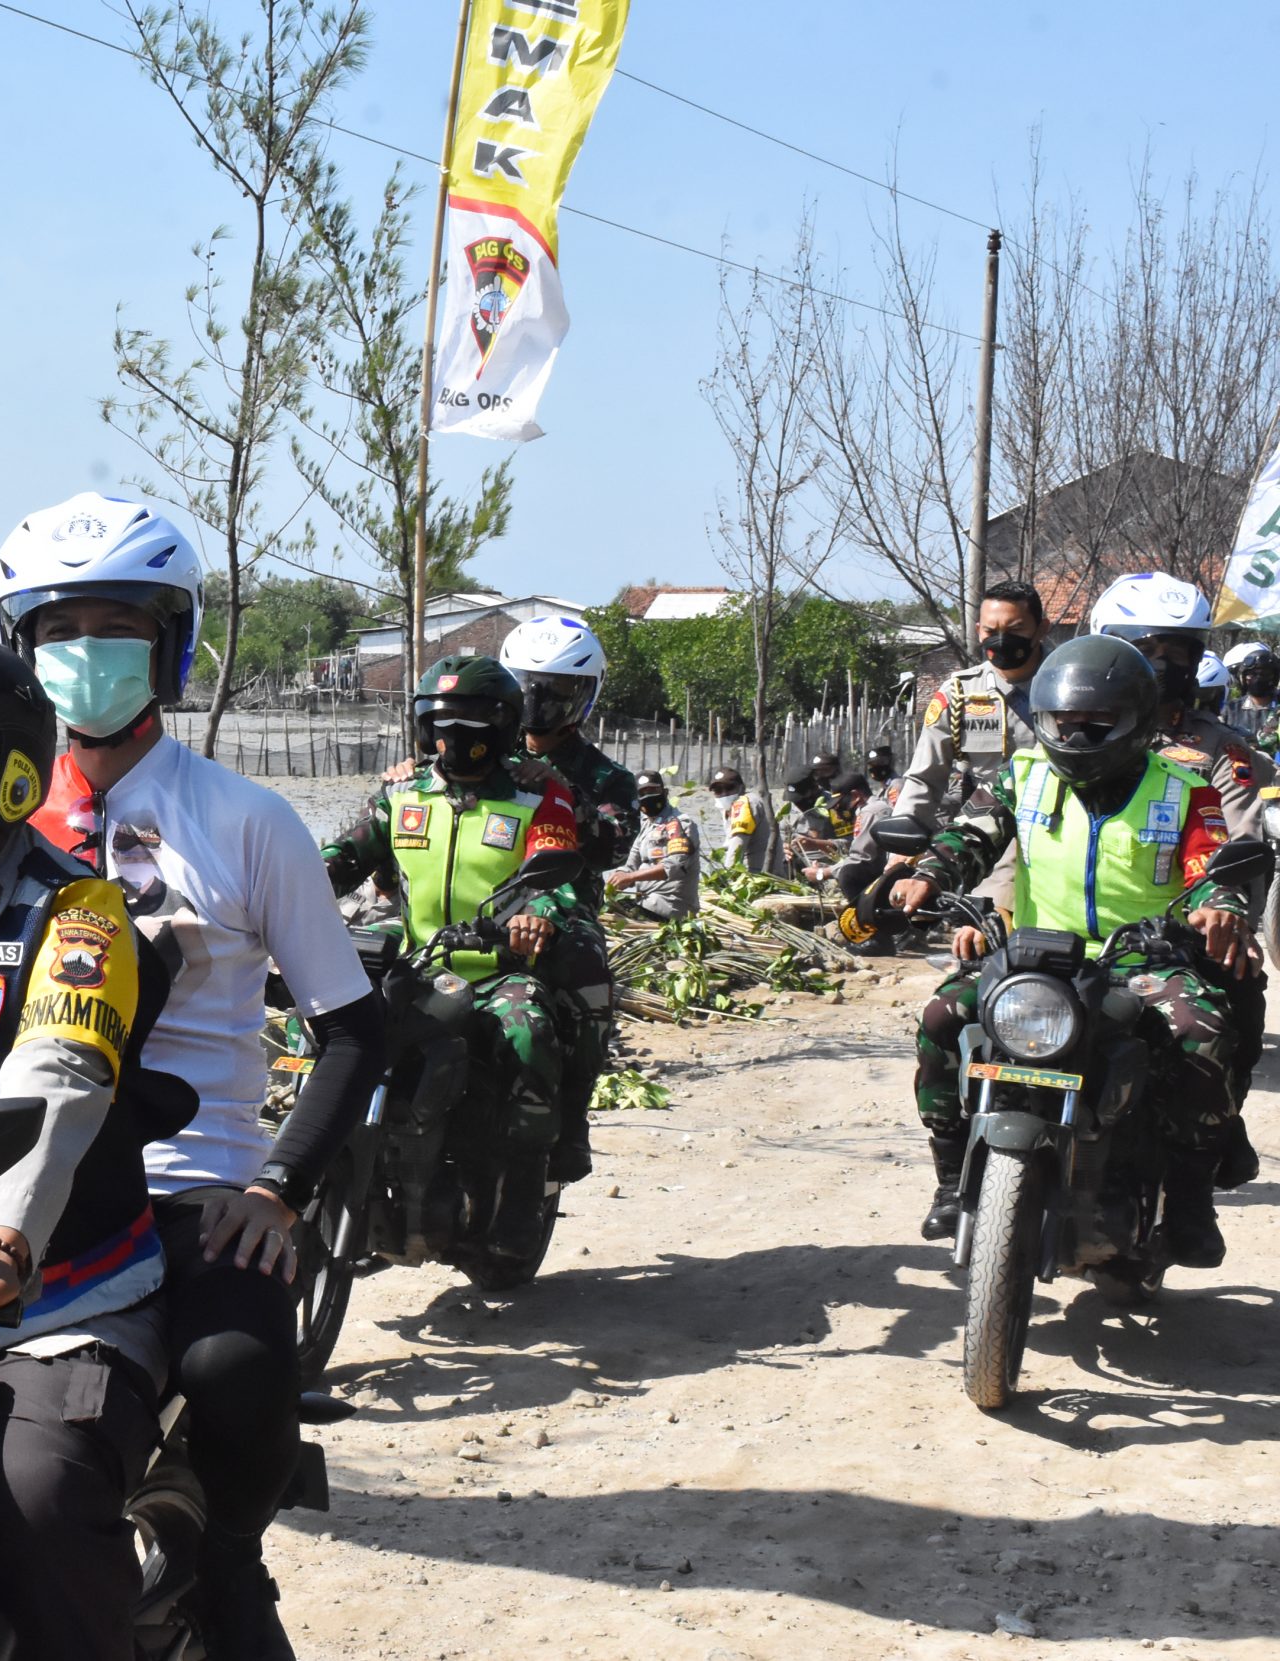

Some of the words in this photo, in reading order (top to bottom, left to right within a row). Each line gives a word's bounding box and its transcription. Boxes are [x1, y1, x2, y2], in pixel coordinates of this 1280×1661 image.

[438, 386, 470, 408] BAG
[478, 392, 513, 413] OPS
[58, 908, 114, 930] POLRES
[60, 914, 110, 934] DEMAK
